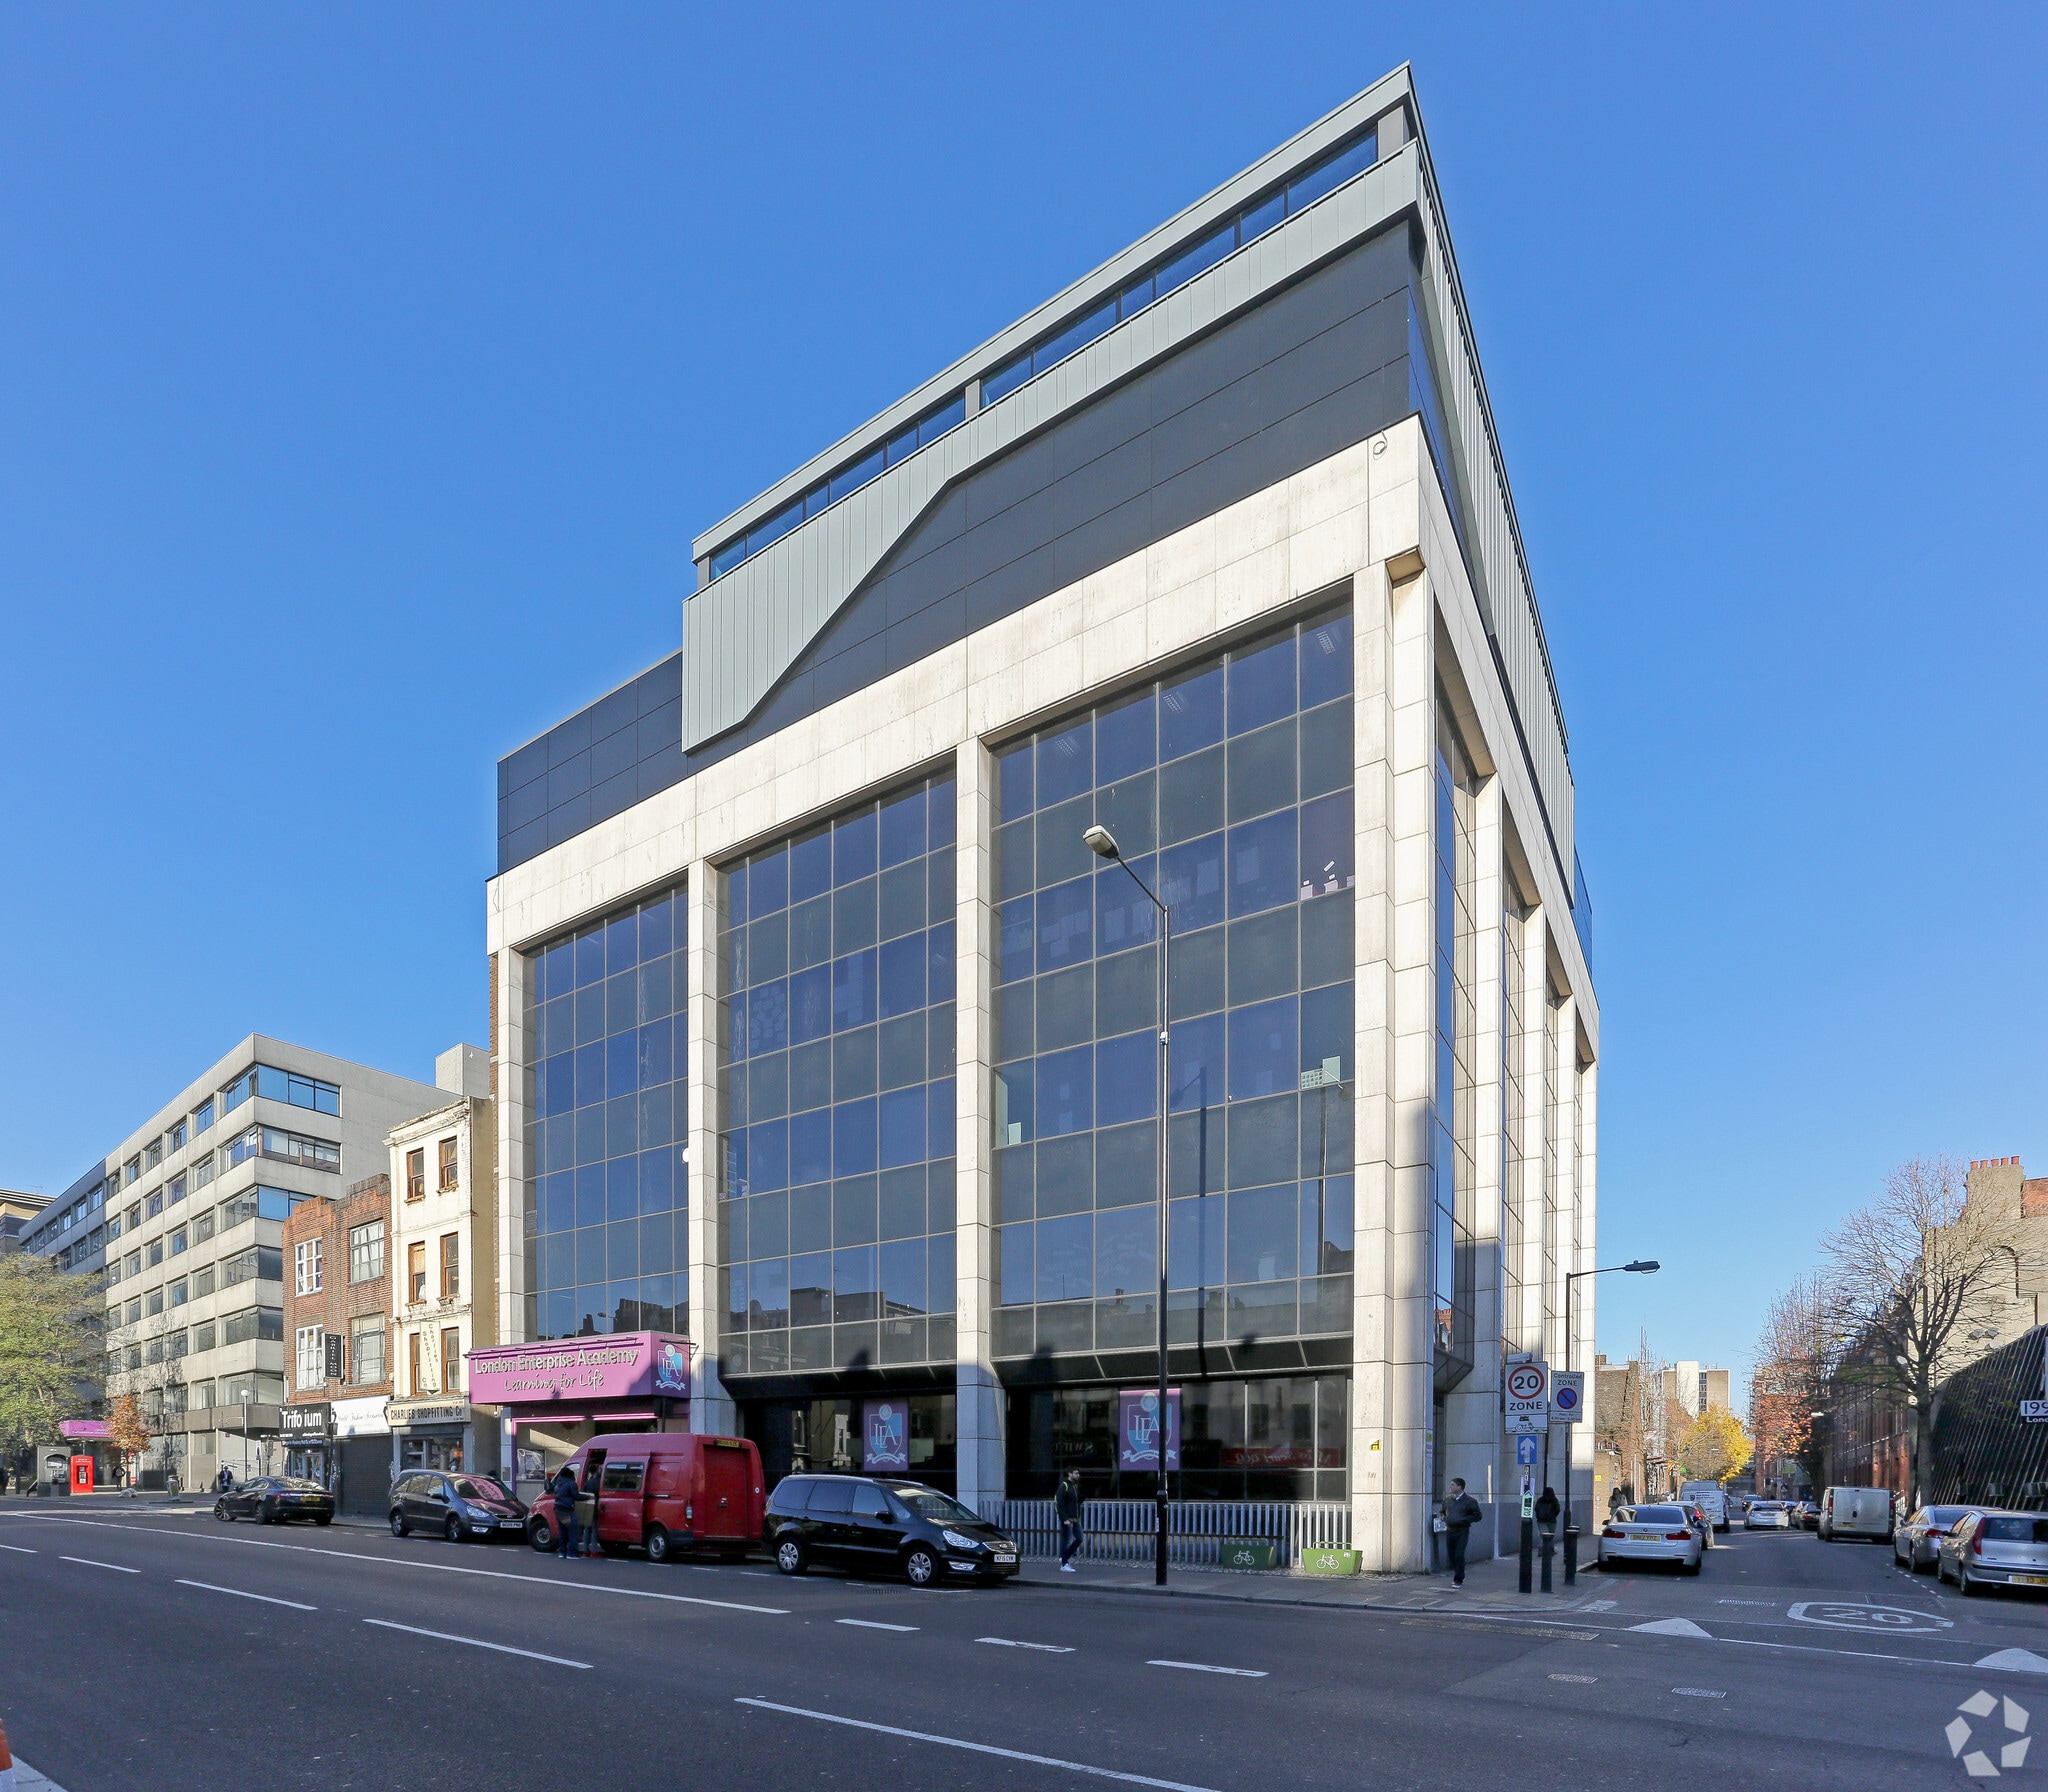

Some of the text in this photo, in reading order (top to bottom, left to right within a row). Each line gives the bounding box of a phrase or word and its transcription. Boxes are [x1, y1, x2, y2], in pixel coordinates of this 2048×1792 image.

[474, 1347, 640, 1375] London Enterprise Academy
[504, 1368, 604, 1394] Learning for Life
[1514, 1375, 1539, 1390] 20
[1557, 1379, 1578, 1387] ZONE
[390, 1408, 415, 1421] CHARLIES
[417, 1406, 453, 1419] SHOPFITTING
[1509, 1402, 1543, 1411] ZONE
[874, 1424, 898, 1449] LEA
[1822, 1607, 1913, 1624] 20
